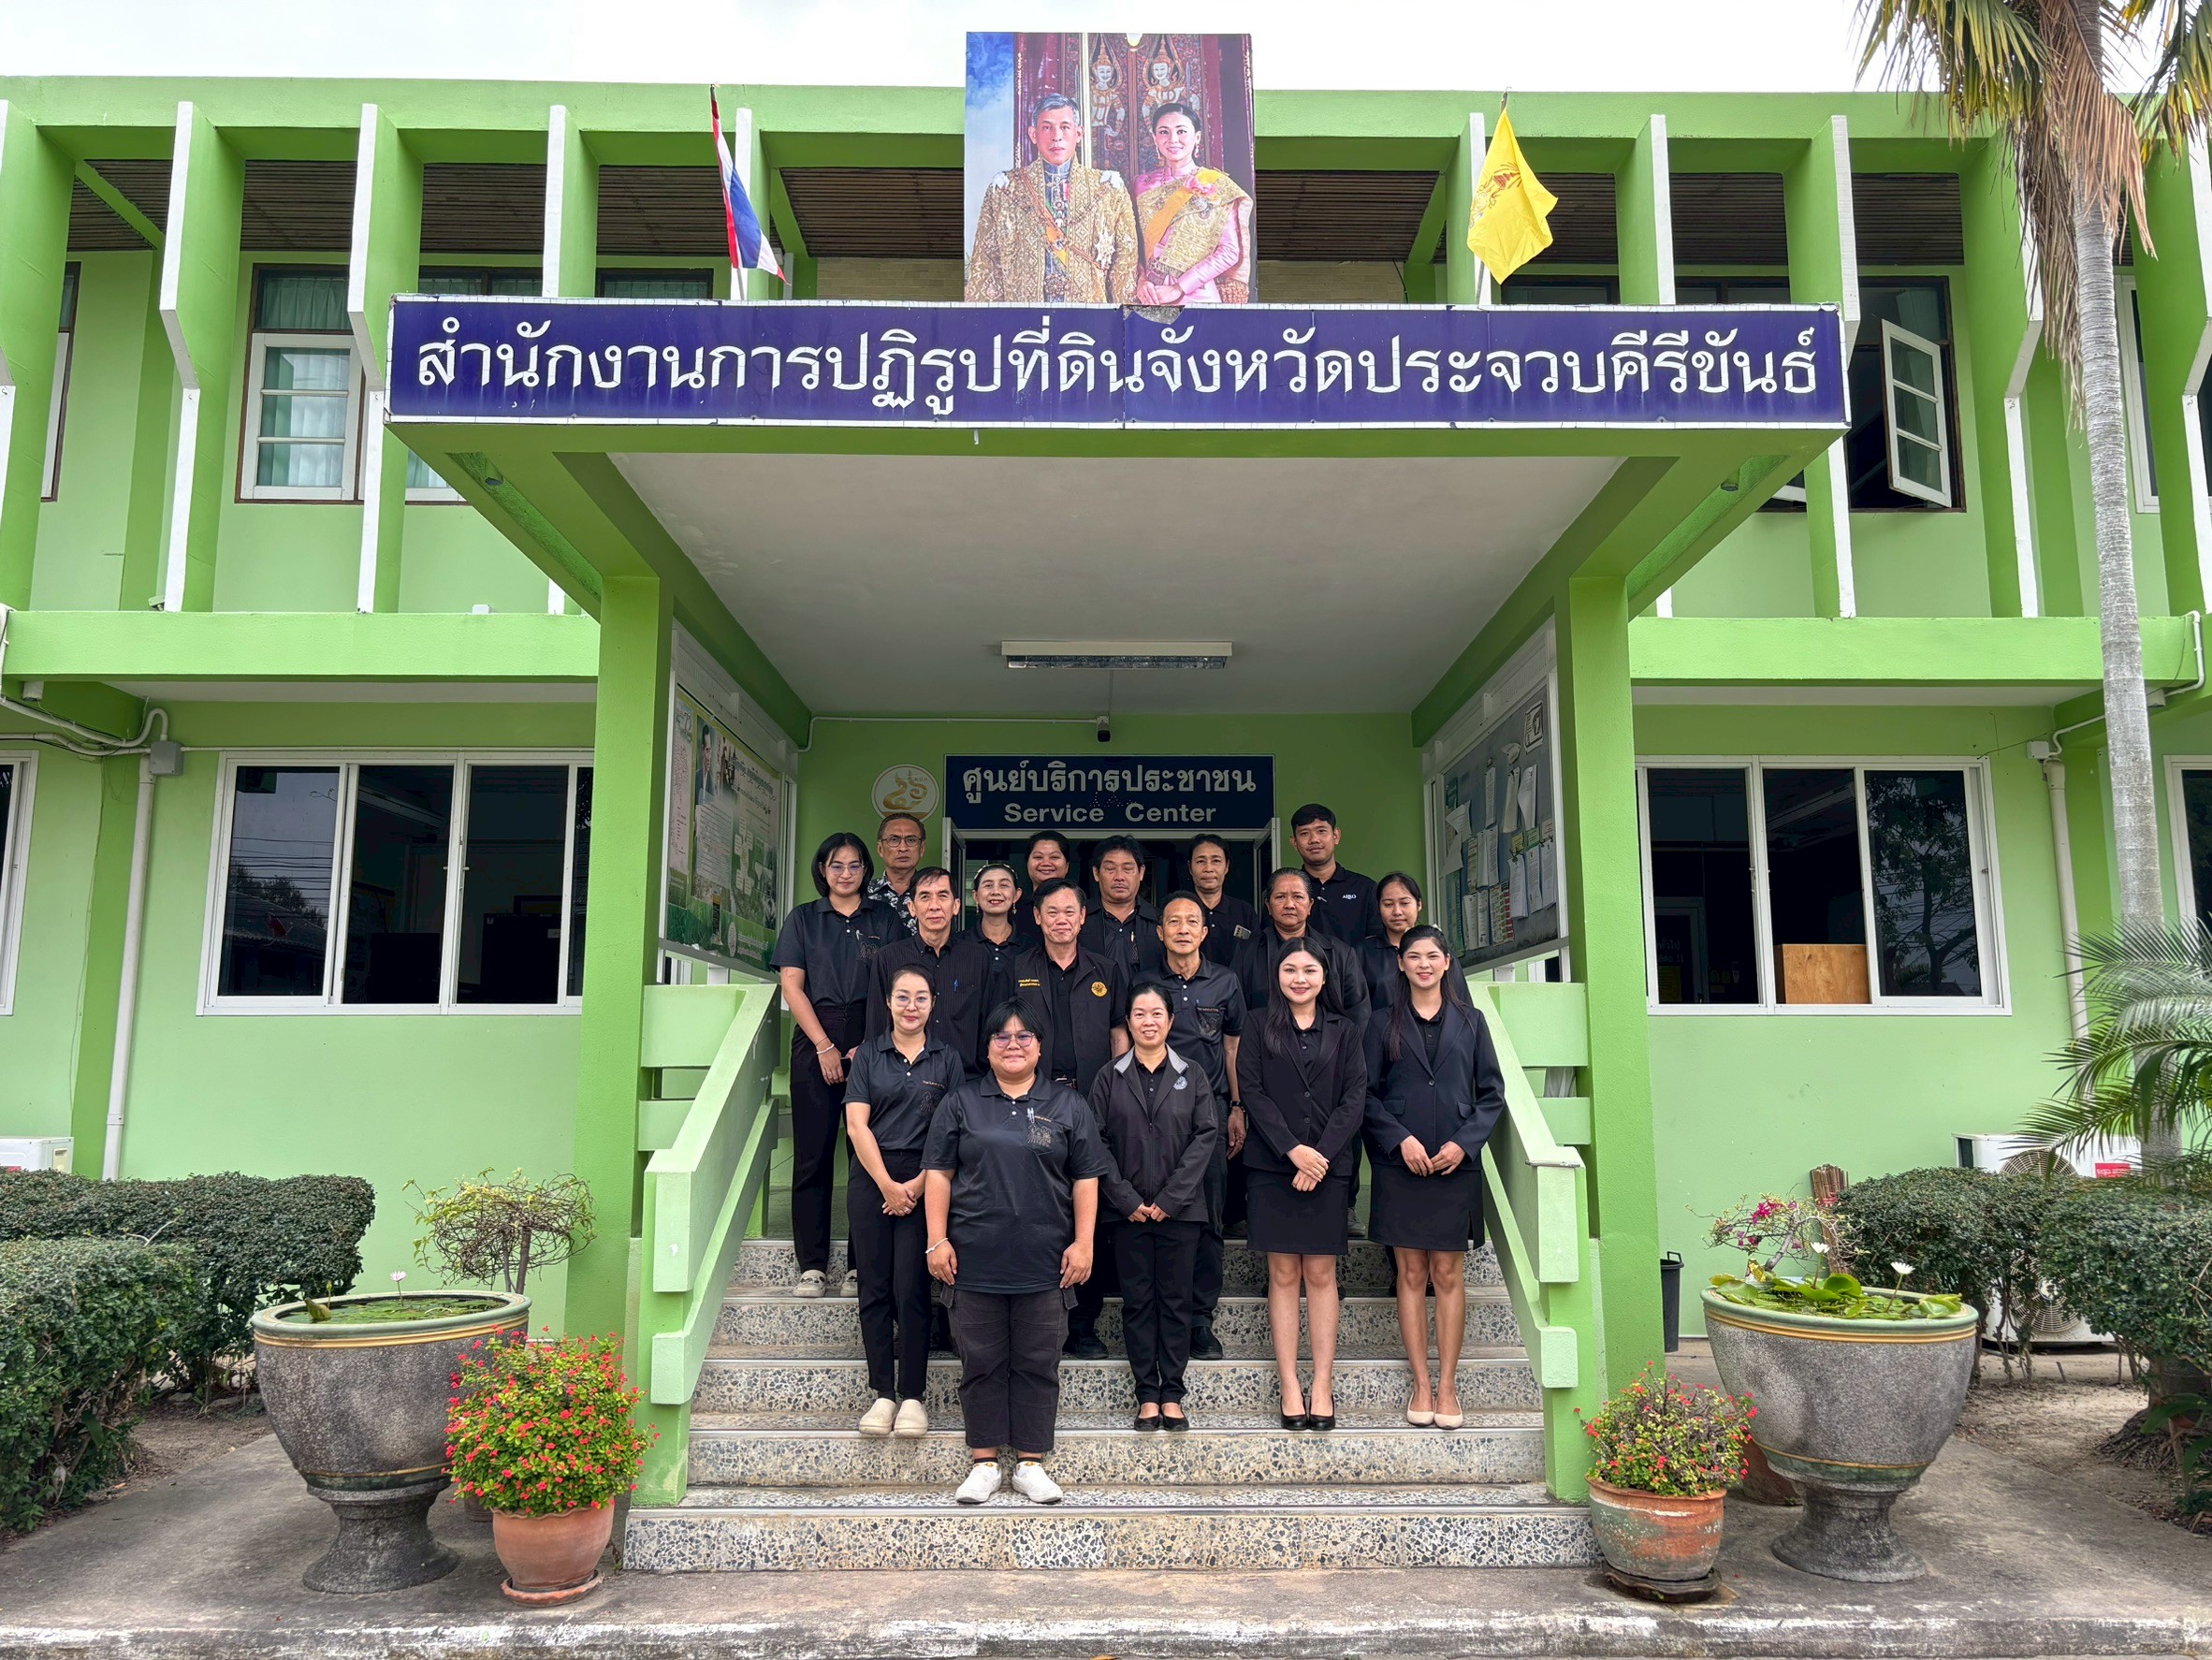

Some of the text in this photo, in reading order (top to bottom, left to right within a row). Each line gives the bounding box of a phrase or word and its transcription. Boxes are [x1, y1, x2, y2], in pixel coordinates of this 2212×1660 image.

[418, 316, 1816, 415] สำนักงานการปฏิรูปที่ดินจังหวัดประจวบคีรีขันธ์
[963, 760, 1257, 804] ศูนย์บริการประชาชน
[1004, 803, 1216, 823] Service Center
